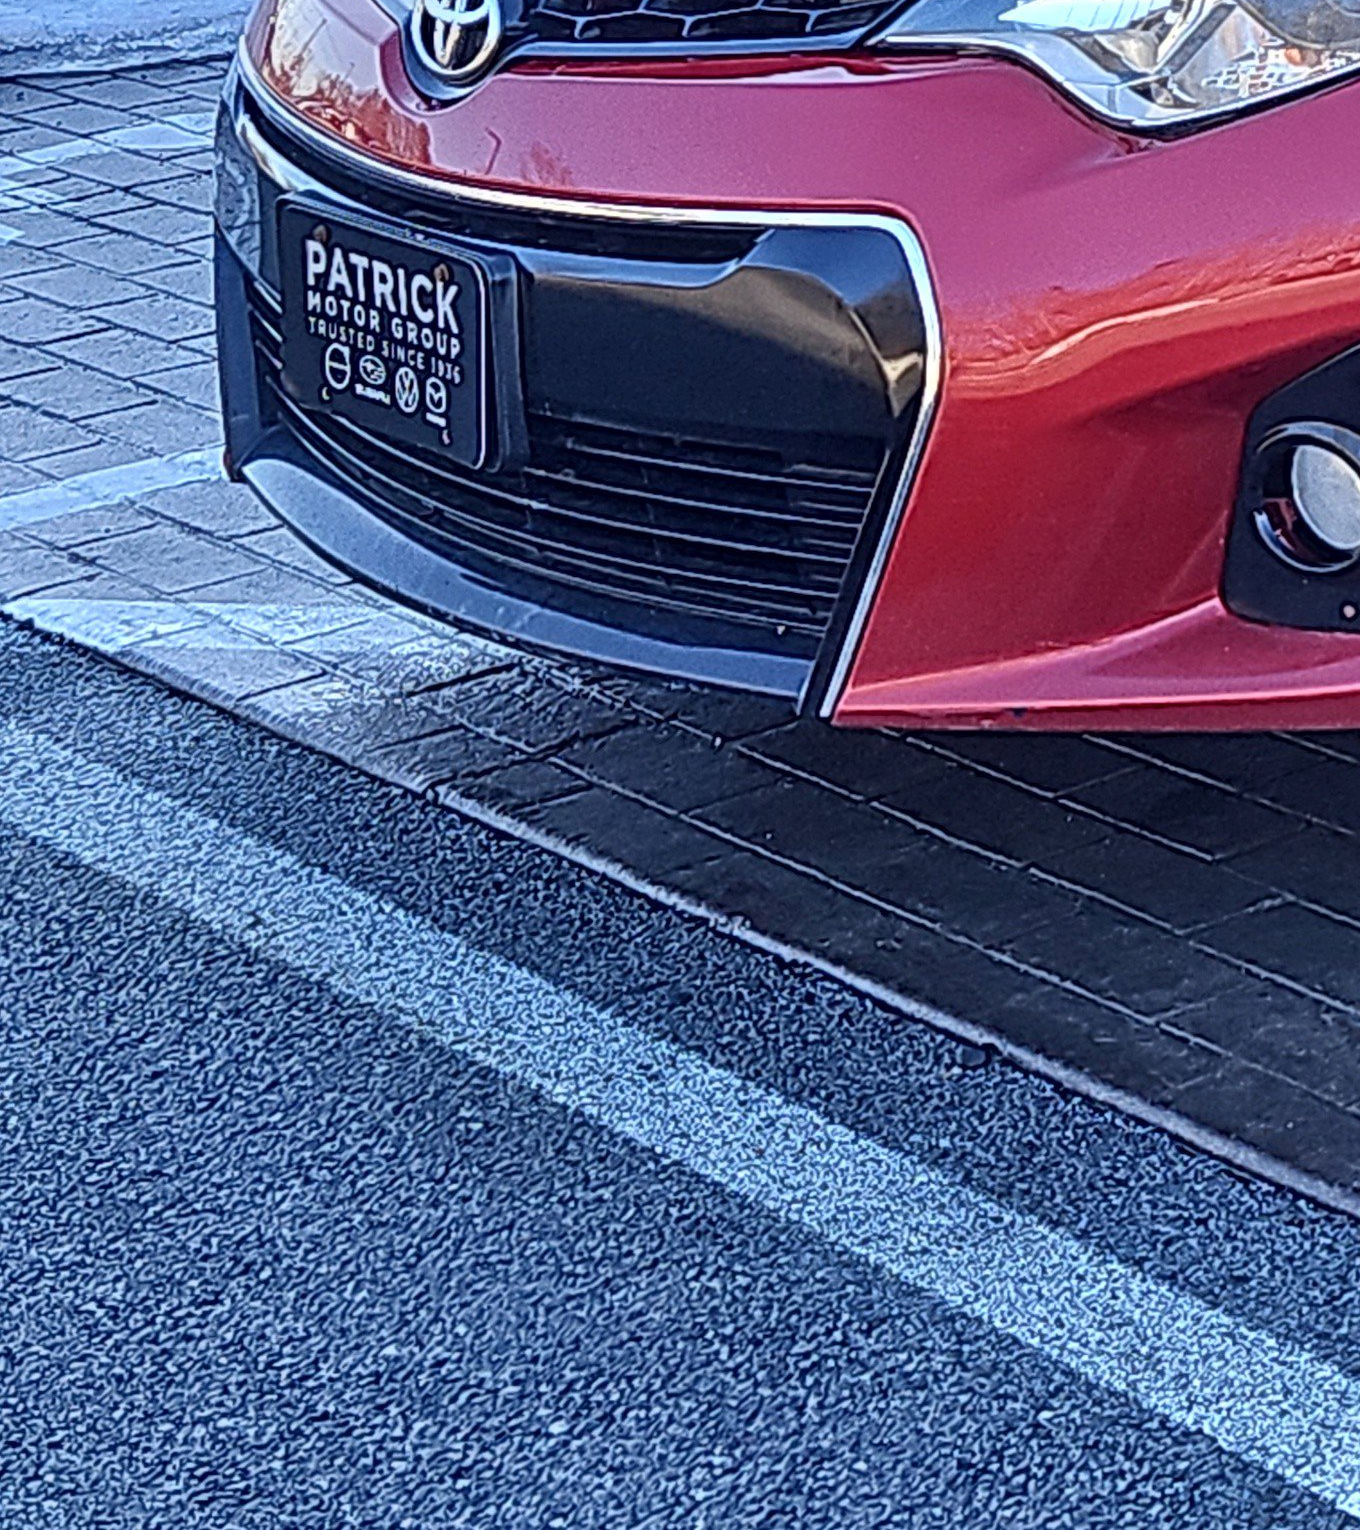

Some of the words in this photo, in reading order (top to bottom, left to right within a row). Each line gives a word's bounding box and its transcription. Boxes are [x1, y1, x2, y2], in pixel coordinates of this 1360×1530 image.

[305, 239, 459, 334] PATRICK
[306, 290, 381, 333] MOTOR
[391, 317, 461, 359] GROUP
[307, 315, 375, 352] TRUSTED
[381, 340, 425, 370] SINCE
